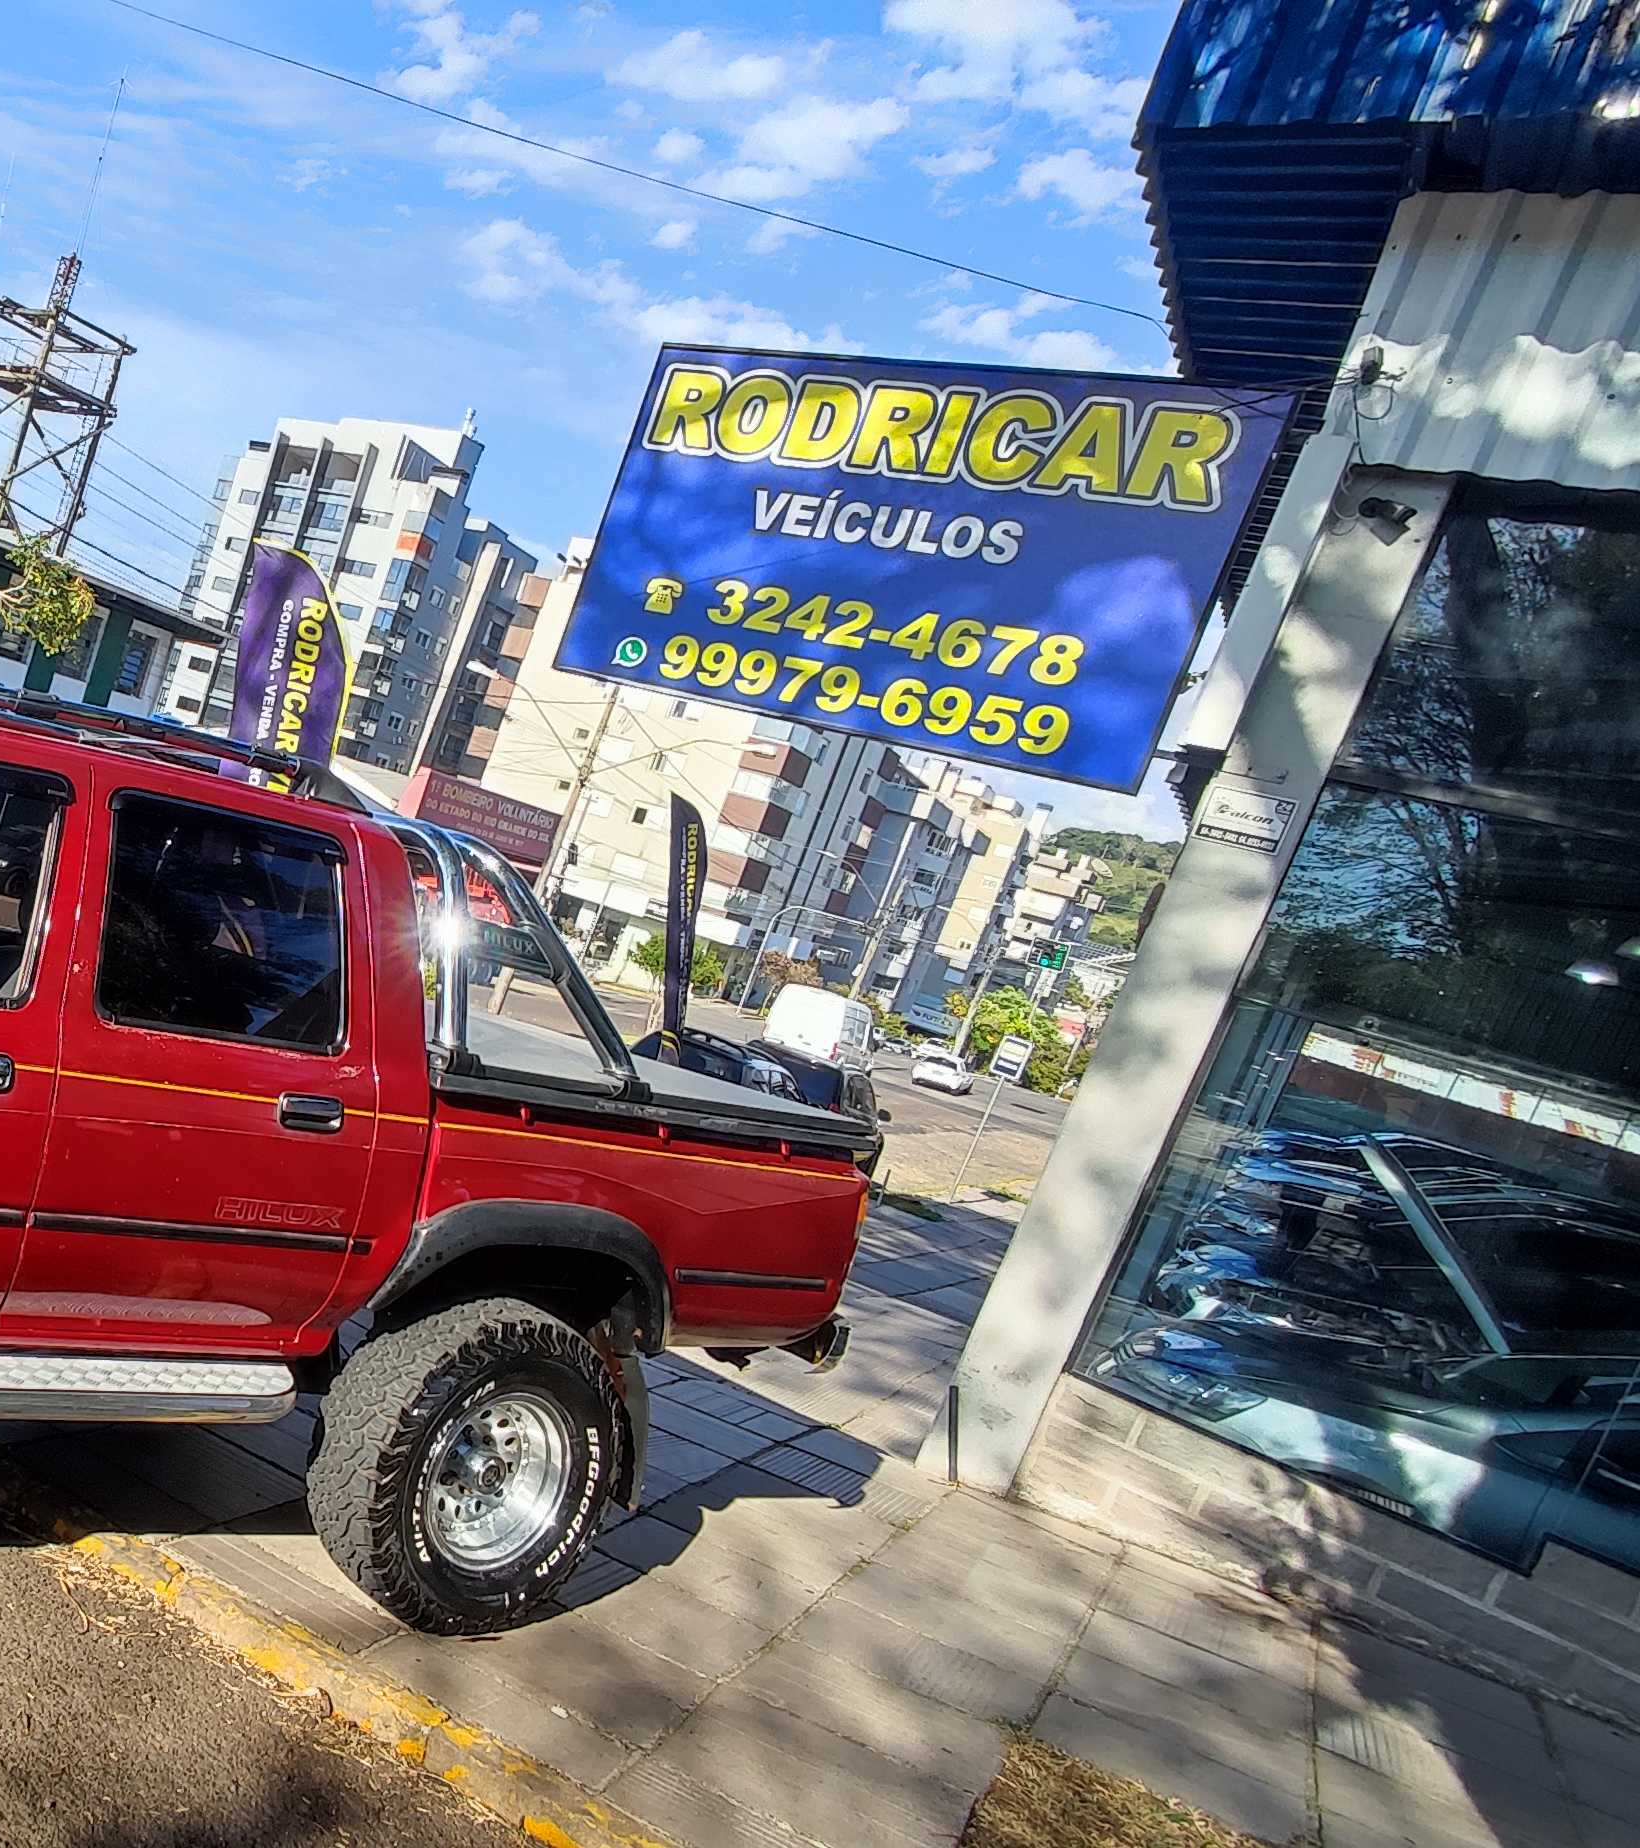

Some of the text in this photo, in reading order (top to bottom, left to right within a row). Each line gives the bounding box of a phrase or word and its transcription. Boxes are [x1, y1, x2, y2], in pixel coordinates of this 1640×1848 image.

[644, 365, 1238, 510] RODRICAR
[752, 489, 1024, 565] VEÍCULOS
[269, 599, 295, 671] COMPRA
[274, 598, 329, 753] RODRICAR
[707, 579, 1085, 688] 3242-4678
[256, 684, 278, 740] VENDA
[660, 635, 1071, 756] 99979-6959
[497, 801, 554, 830] VOLUNTÁRIO
[214, 1196, 346, 1229] HILUX
[535, 1427, 600, 1578] BFGoodrich
